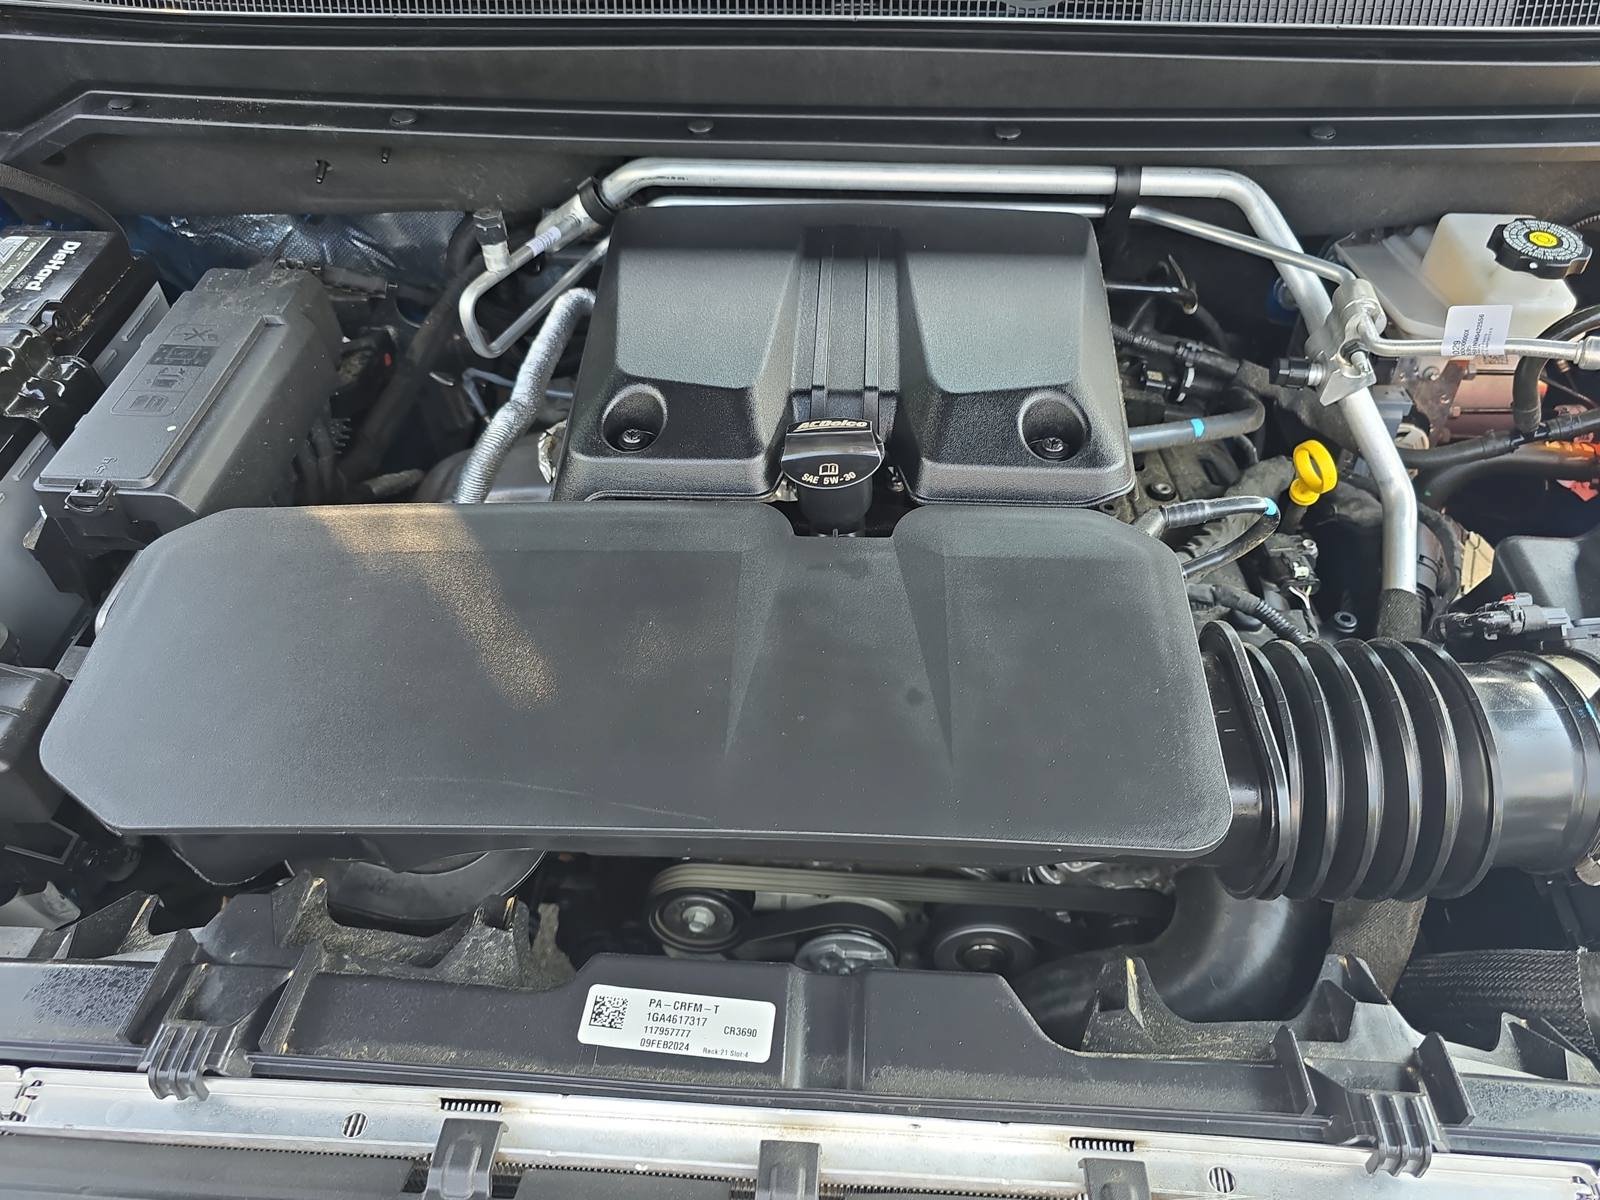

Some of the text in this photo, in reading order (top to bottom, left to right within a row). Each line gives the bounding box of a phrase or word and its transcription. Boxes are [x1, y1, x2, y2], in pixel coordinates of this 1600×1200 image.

[25, 241, 81, 291] DieHard
[794, 420, 868, 432] ACDelco
[802, 472, 856, 484] SAE 5W-30
[648, 998, 720, 1013] PA-CRFM-T
[646, 1012, 708, 1027] 1GA4617317
[643, 1026, 692, 1038] 117957777
[723, 1026, 758, 1038] CR3690
[640, 1037, 690, 1052] 09FEB2024
